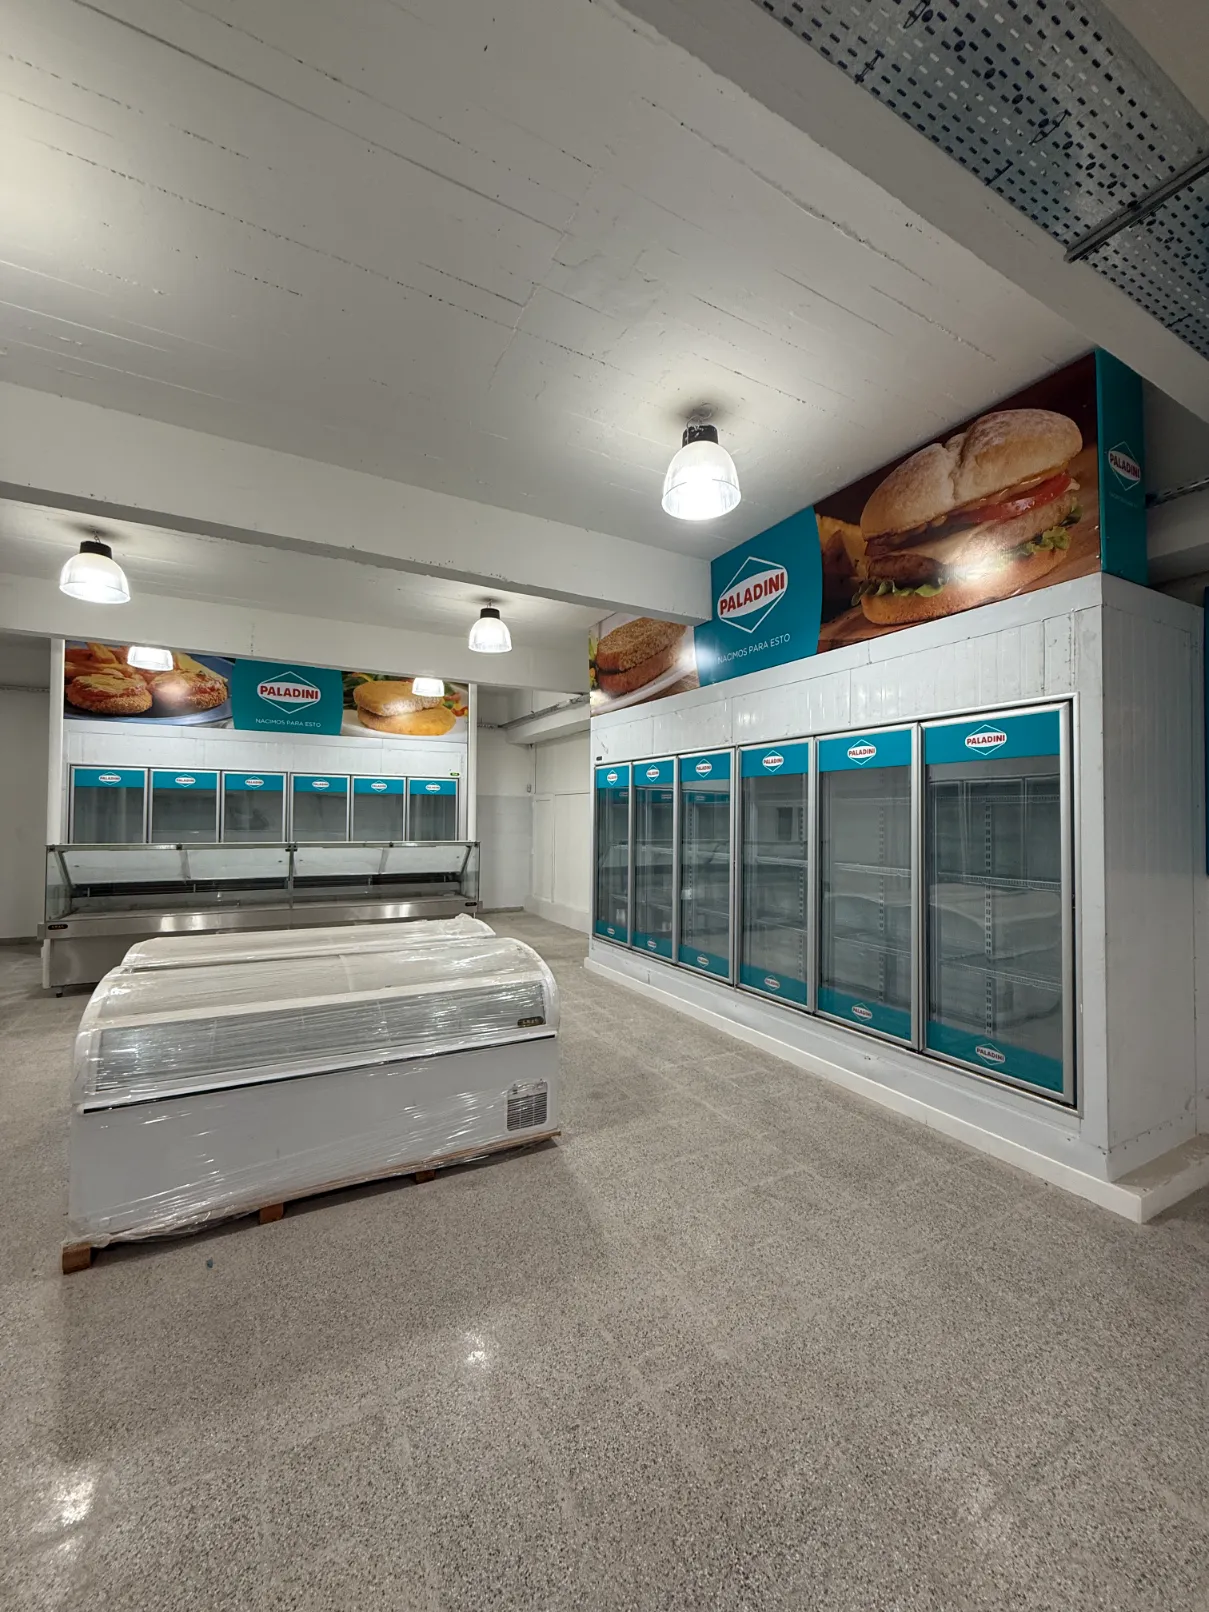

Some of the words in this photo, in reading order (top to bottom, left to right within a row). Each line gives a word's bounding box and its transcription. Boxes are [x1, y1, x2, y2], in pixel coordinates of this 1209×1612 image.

[1109, 452, 1140, 479] PALADINI
[720, 571, 785, 615] PALADINI
[717, 647, 748, 664] NACIMOS
[748, 640, 769, 654] PARA
[770, 633, 791, 647] ESTO
[259, 685, 319, 700] PALADINI
[255, 718, 286, 726] NACIMOS
[286, 719, 304, 727] PARA
[967, 734, 1006, 745] PALADINI
[848, 748, 876, 756] PALADINI
[853, 1007, 872, 1018] PALADINI
[976, 1047, 1005, 1061] PALADINI
